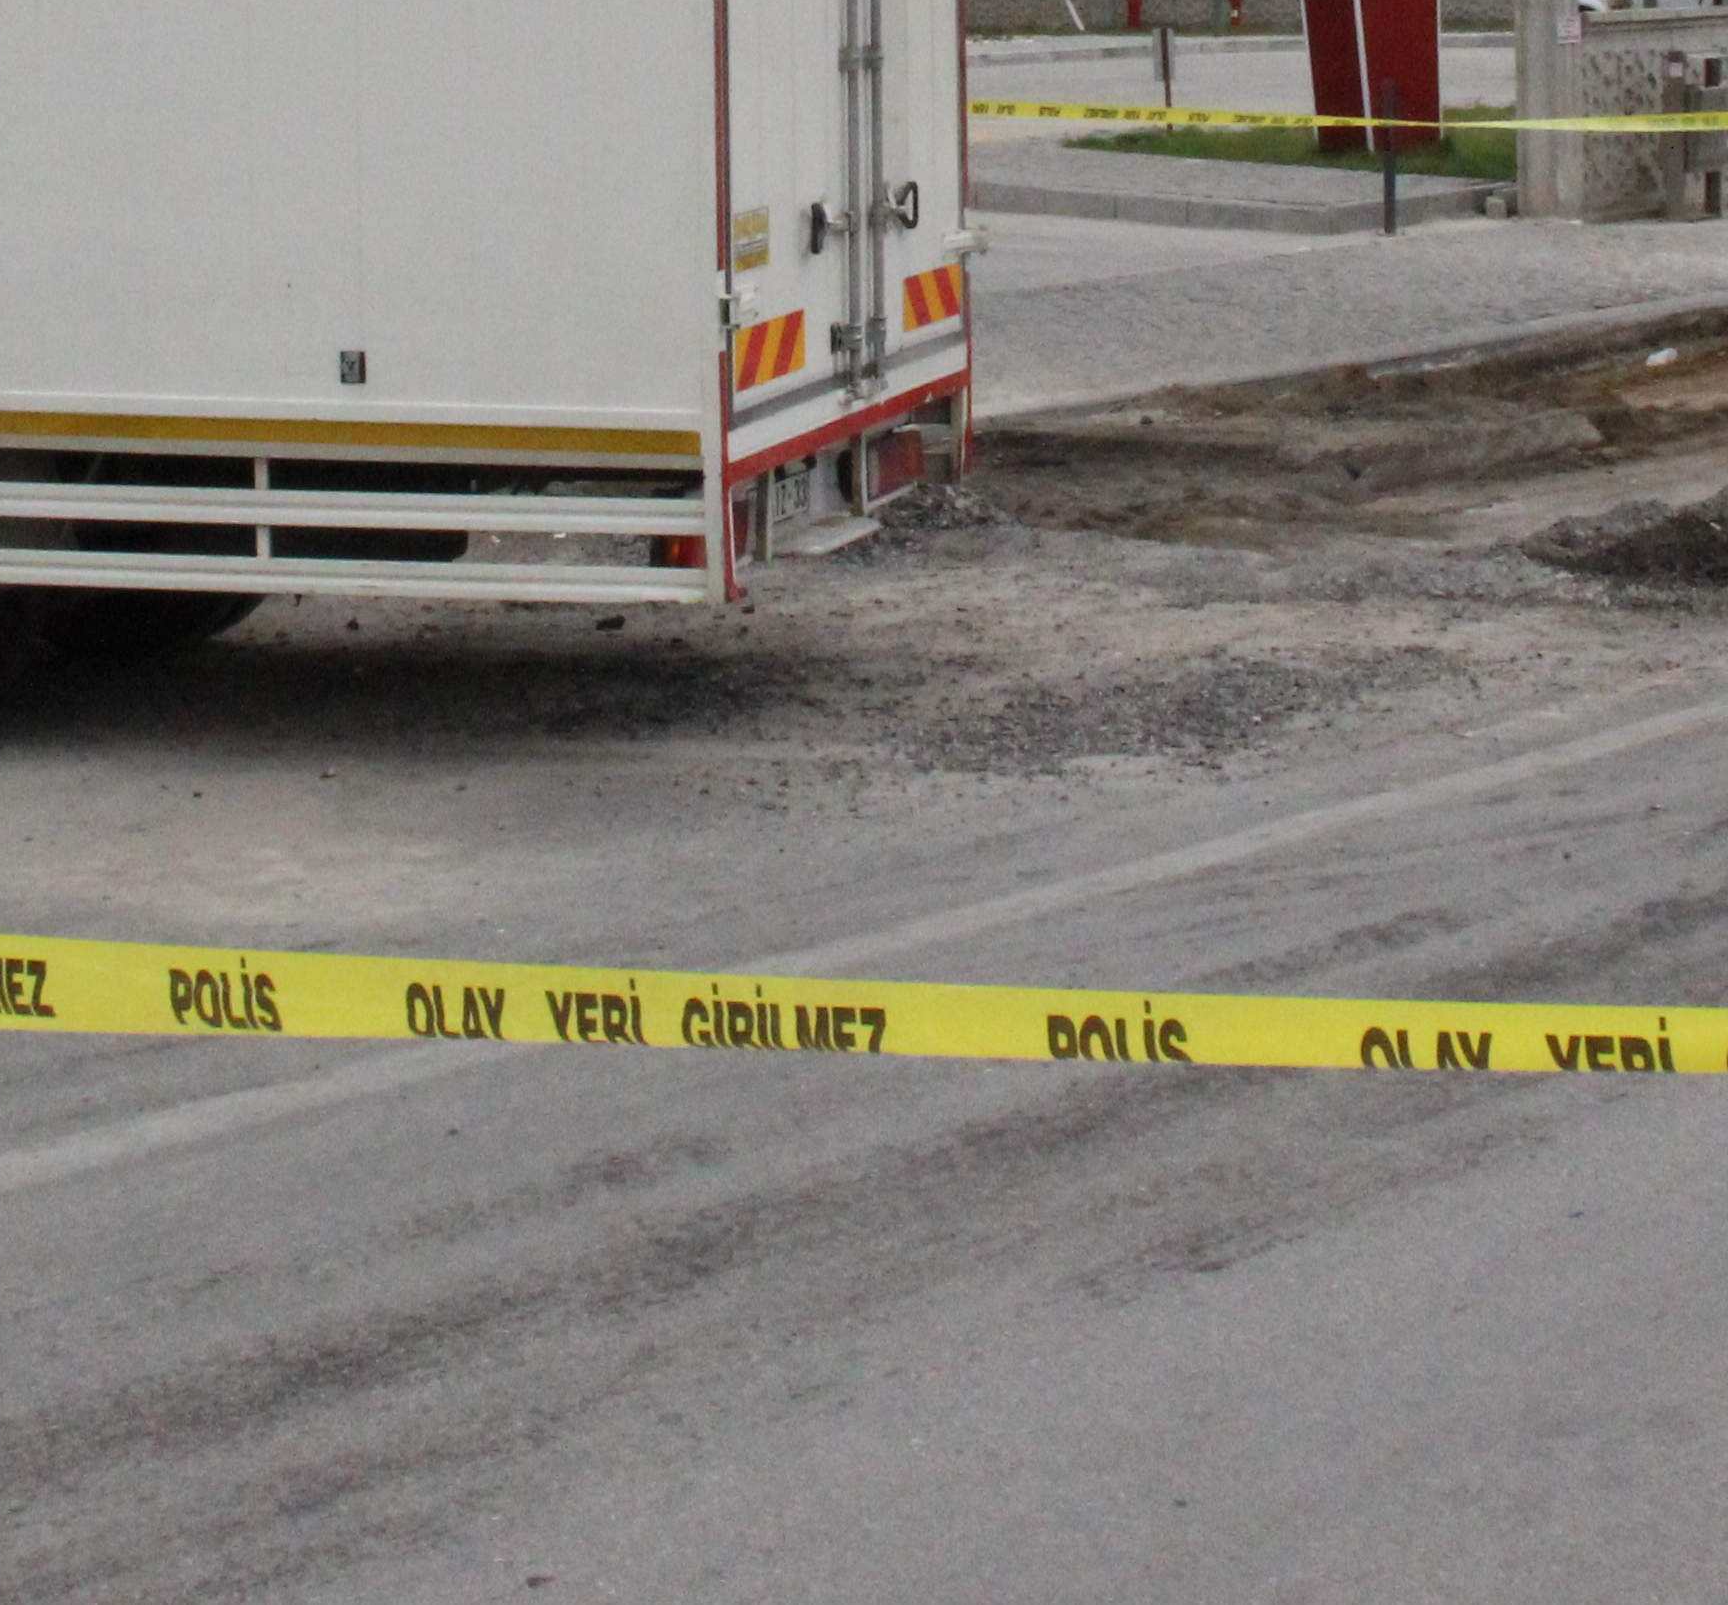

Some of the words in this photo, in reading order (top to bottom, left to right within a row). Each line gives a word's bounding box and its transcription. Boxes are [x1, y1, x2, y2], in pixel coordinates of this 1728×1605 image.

[169, 957, 282, 1032] POLİS
[406, 983, 504, 1040] OLAY
[545, 979, 649, 1048] YERİ
